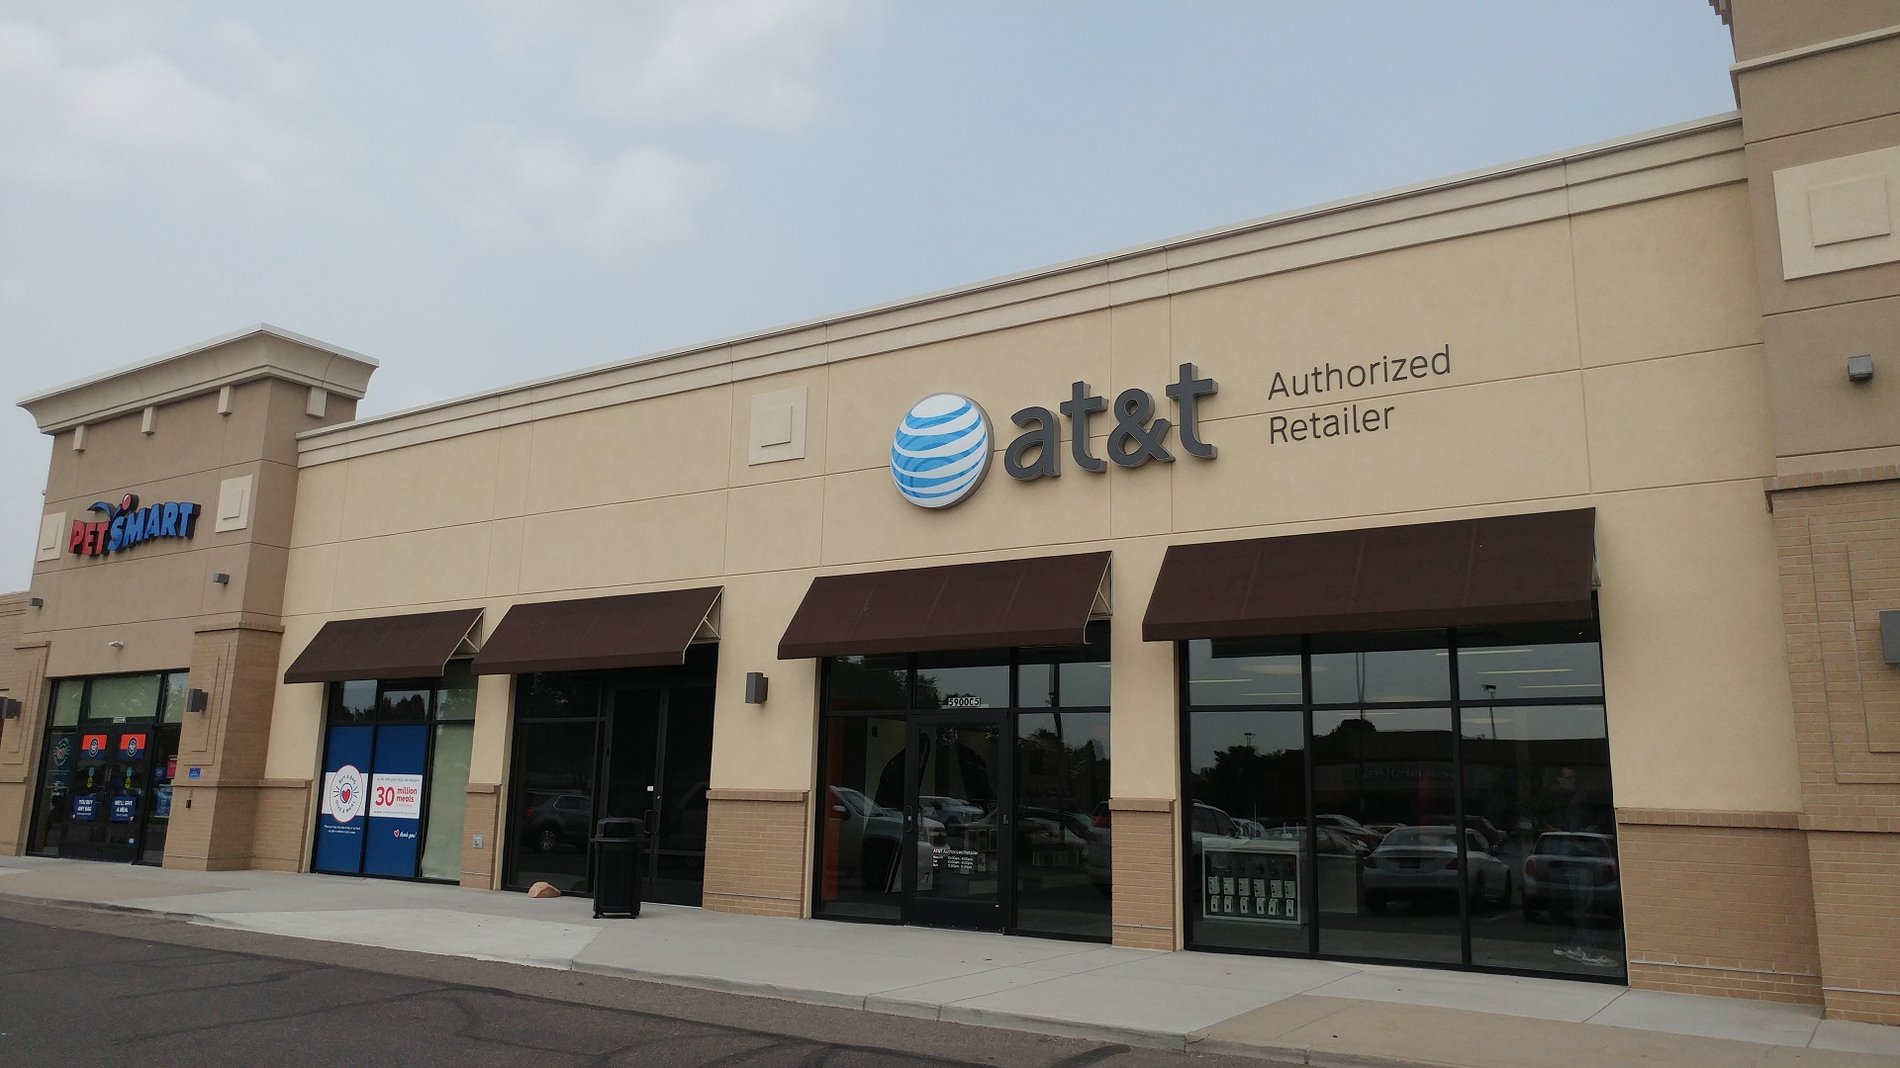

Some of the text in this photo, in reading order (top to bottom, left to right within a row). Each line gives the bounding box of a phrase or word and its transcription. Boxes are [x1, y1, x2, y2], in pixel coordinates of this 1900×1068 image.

[1268, 344, 1451, 400] Authorized
[1003, 362, 1218, 482] at&t
[1269, 401, 1396, 446] Retailer
[949, 697, 980, 706] 5900C5
[375, 786, 395, 806] 30
[396, 795, 415, 803] meals
[397, 787, 417, 795] million
